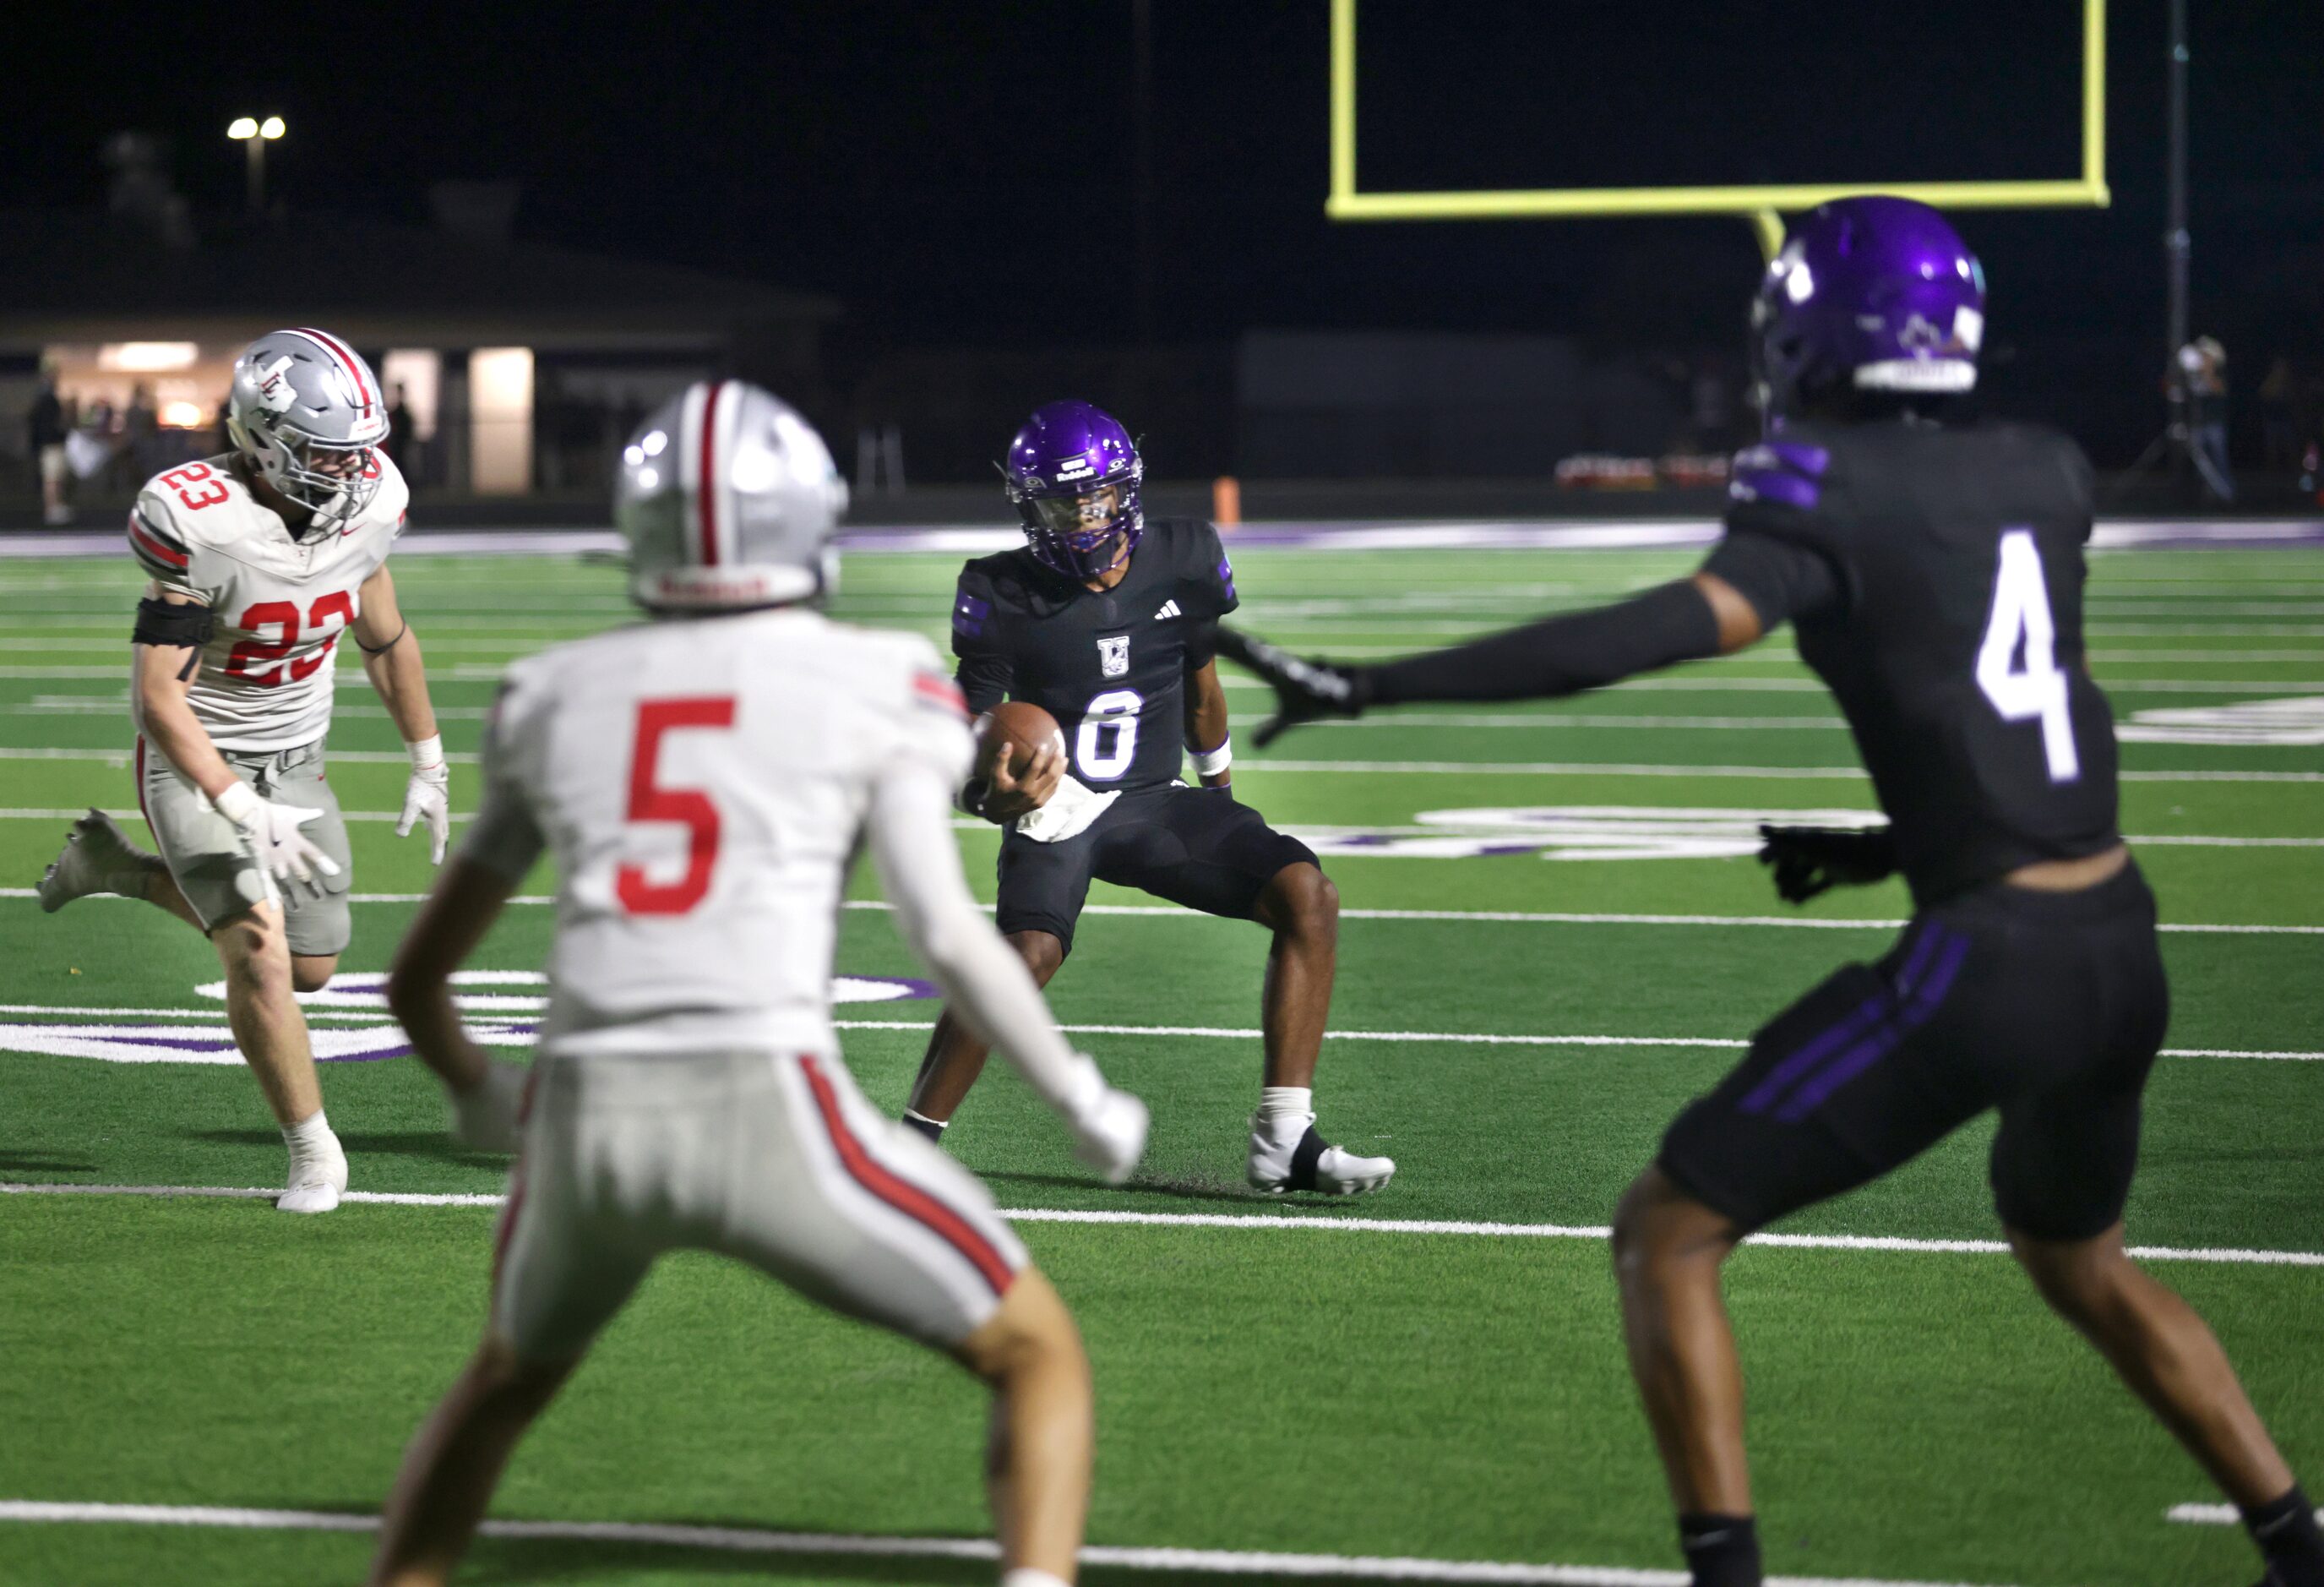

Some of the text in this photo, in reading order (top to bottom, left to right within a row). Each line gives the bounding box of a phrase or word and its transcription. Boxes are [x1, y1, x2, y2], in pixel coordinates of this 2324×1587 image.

[160, 464, 230, 510] 23
[225, 590, 355, 685] 23
[1976, 526, 2080, 782] 4
[1074, 688, 1146, 782] 6
[614, 695, 737, 918] 5
